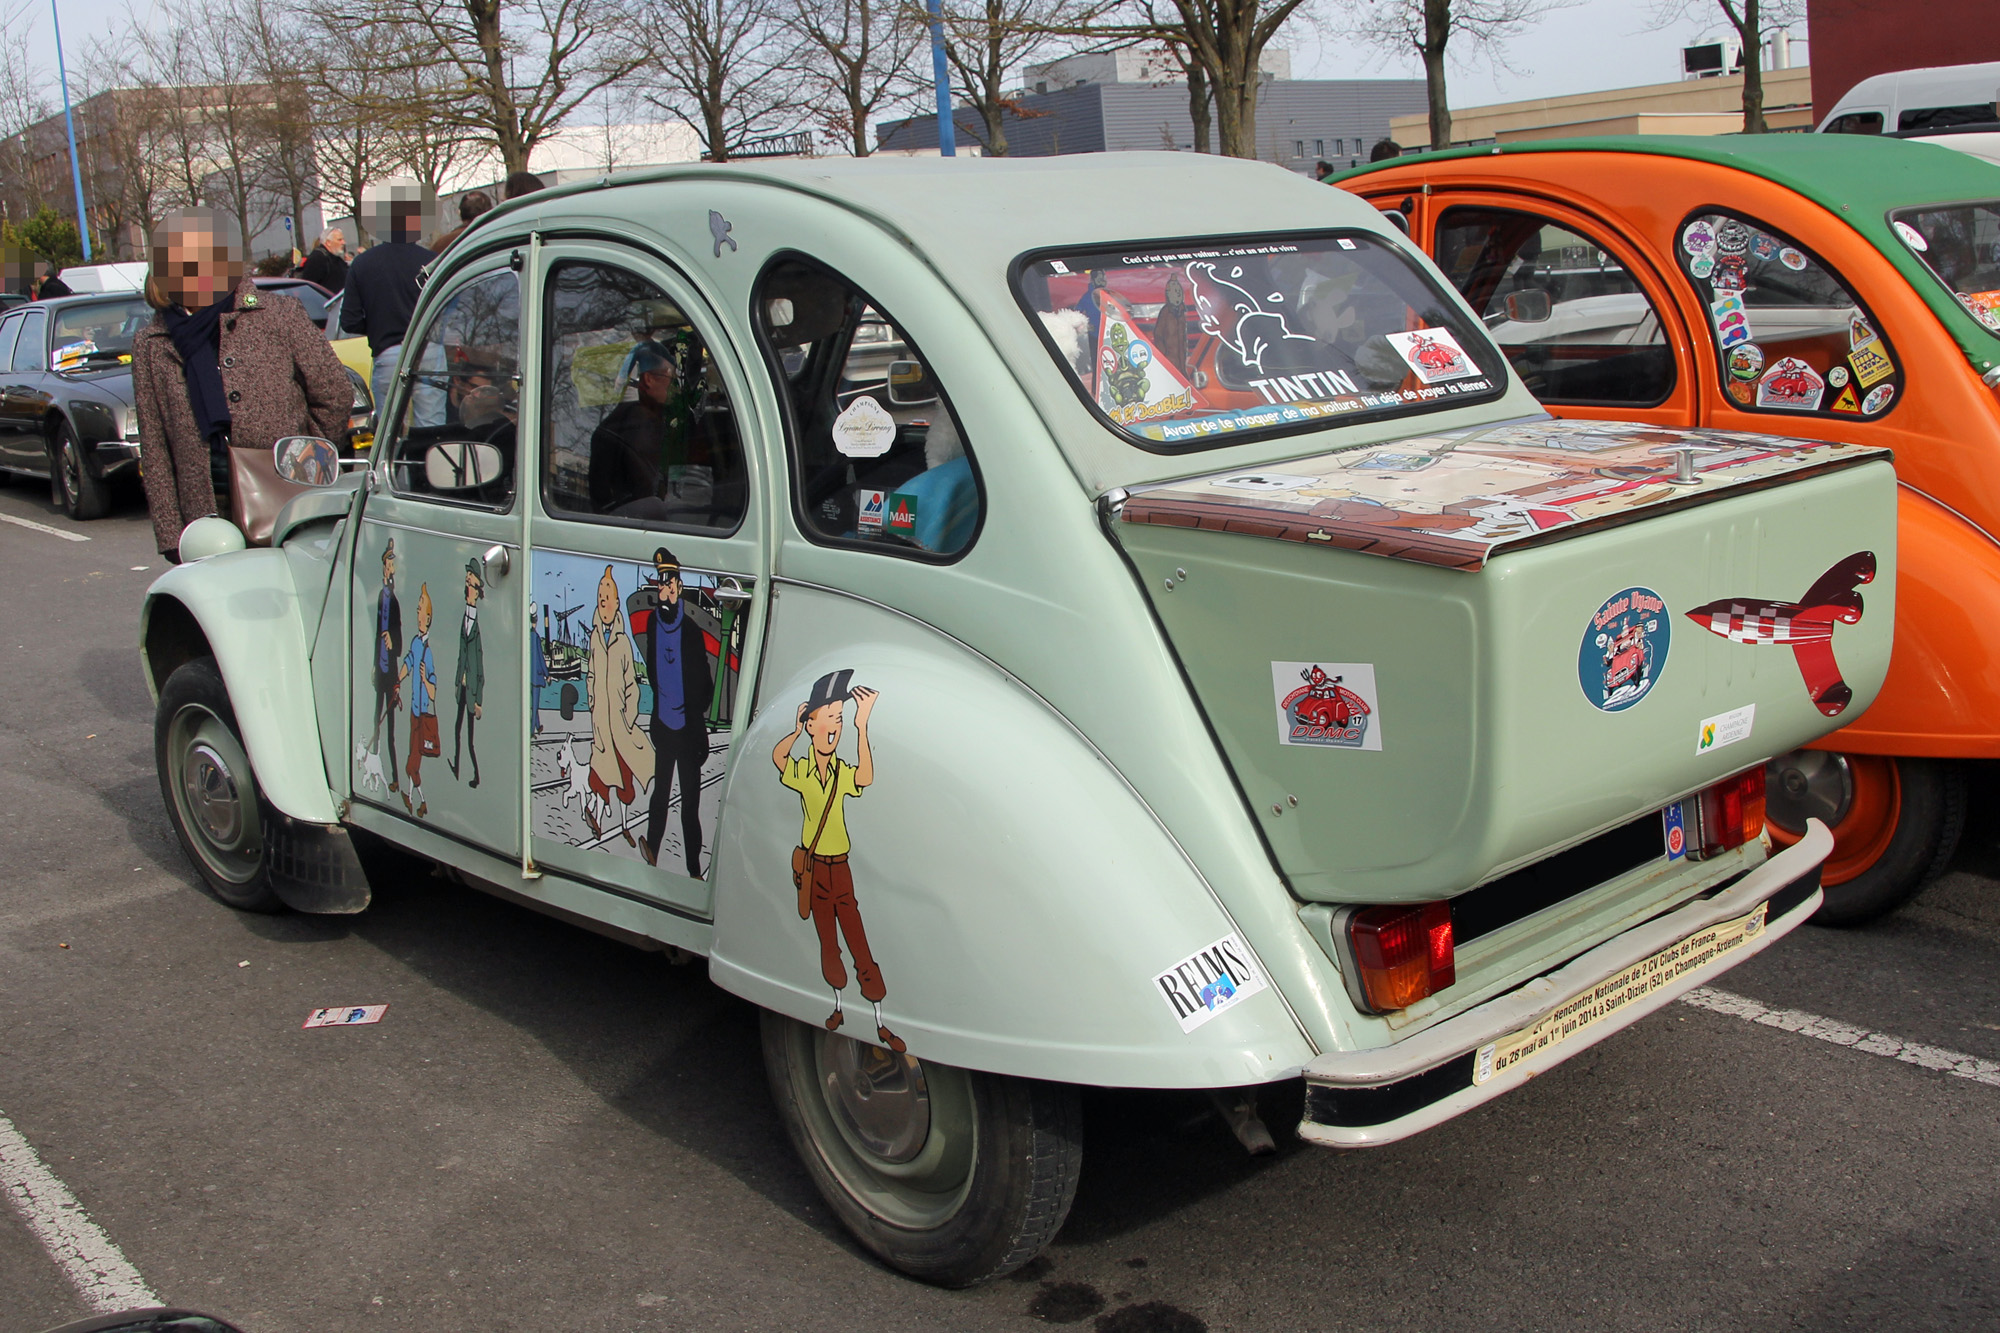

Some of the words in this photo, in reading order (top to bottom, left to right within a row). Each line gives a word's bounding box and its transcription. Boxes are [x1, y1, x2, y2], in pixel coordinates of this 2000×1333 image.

[1122, 256, 1142, 265] Ceci
[1142, 254, 1163, 263] n'est
[1163, 255, 1178, 263] pas
[1193, 250, 1221, 259] voiture
[1229, 248, 1246, 256] c'est
[1258, 246, 1269, 254] art
[1269, 245, 1279, 253] de
[1279, 244, 1298, 252] vivre
[1248, 369, 1360, 405] TINTIN
[1426, 365, 1465, 377] DDMC
[1137, 387, 1192, 419] DOUBLE!
[1162, 422, 1200, 438] Avant
[1201, 420, 1218, 433] de
[1219, 418, 1234, 430] te
[1235, 411, 1280, 428] moquer
[1282, 408, 1297, 420] de
[1299, 406, 1320, 418] ma
[1320, 399, 1363, 415] voiture,
[1360, 395, 1380, 407] fini
[1380, 391, 1403, 406] déjà
[1403, 390, 1417, 401] de
[1417, 387, 1446, 400] payer
[1445, 383, 1459, 394] la
[1459, 380, 1486, 393] tienne
[1764, 394, 1814, 405] DDMC
[889, 511, 915, 523] MAIF
[1594, 598, 1629, 631] Sainte
[1631, 591, 1663, 613] Dyane
[1291, 725, 1361, 740] DDMC
[1352, 716, 1362, 725] 17
[1156, 940, 1251, 1020] REIMS
[1553, 995, 1592, 1022] Rencontre
[1594, 974, 1629, 1000] Nationale
[1631, 967, 1640, 981] de
[1642, 965, 1647, 976] 2
[1649, 957, 1659, 973] CV
[1659, 948, 1680, 967] Clubs
[1680, 943, 1690, 955] de
[1691, 932, 1717, 950] France
[1496, 1056, 1507, 1071] du
[1521, 1040, 1537, 1058] mai
[1538, 1036, 1548, 1049] au
[1561, 1018, 1577, 1039] juin
[1578, 1007, 1598, 1027] 2014
[1599, 1003, 1605, 1016] à
[1605, 981, 1648, 1012] Saint-Dizier
[1649, 972, 1664, 991] (52)
[1664, 967, 1674, 981] en
[1674, 933, 1743, 976] Champagne-Ardenne
